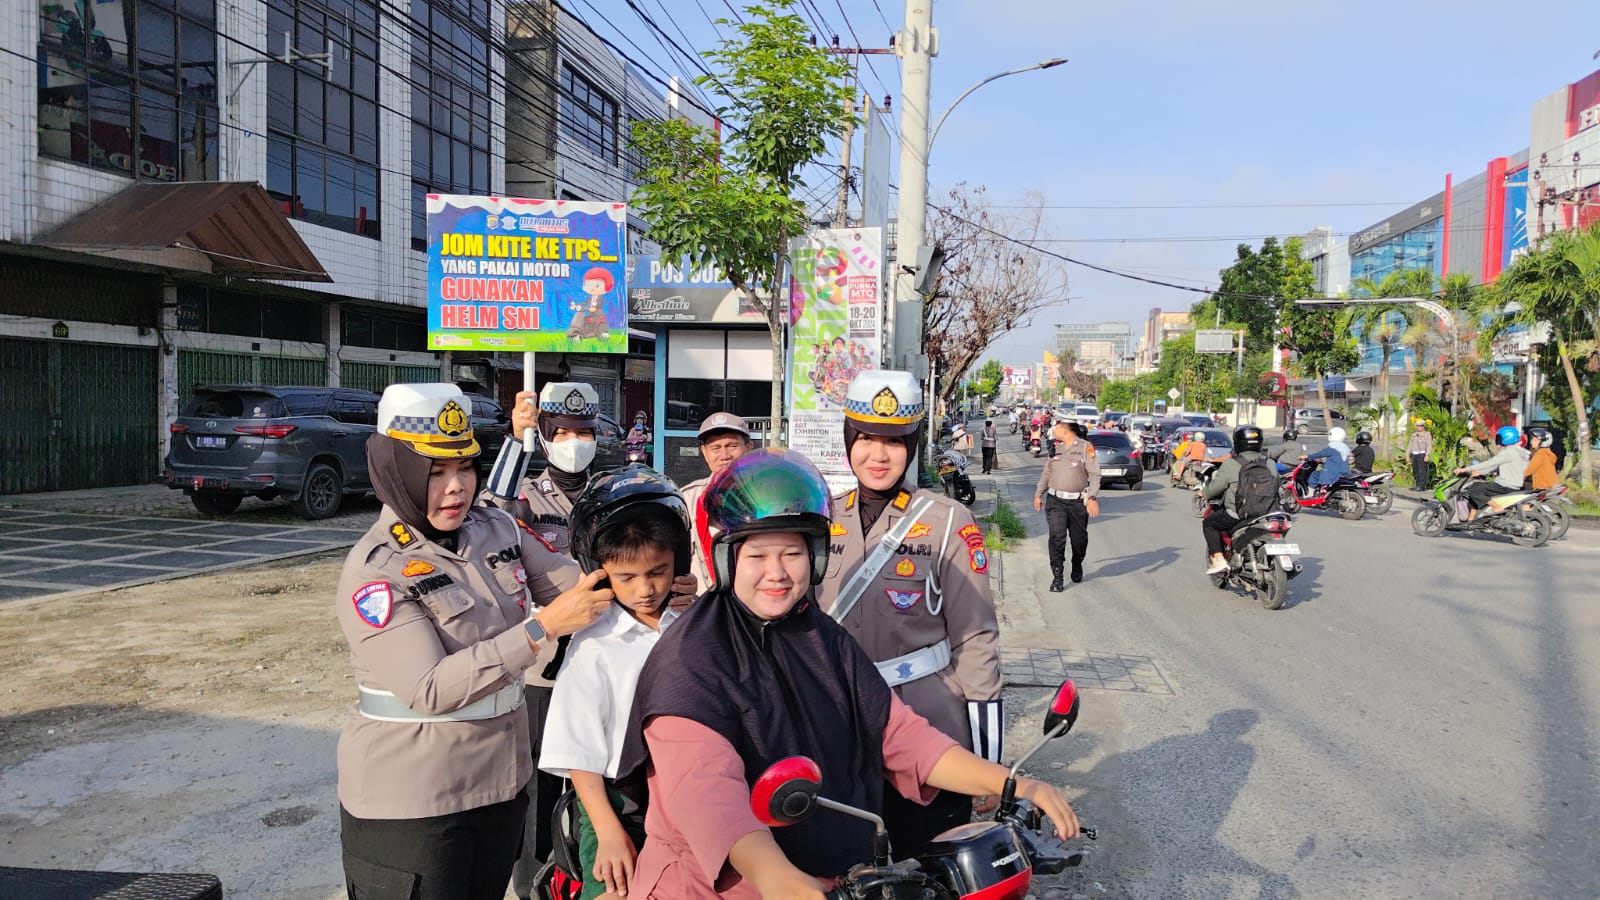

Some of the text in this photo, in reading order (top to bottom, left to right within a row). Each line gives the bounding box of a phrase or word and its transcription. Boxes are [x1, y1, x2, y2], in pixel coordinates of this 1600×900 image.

[440, 233, 483, 257] JOM
[487, 235, 532, 259] KITE
[535, 237, 560, 260] KE
[441, 259, 570, 278] YANG PAKAI MOTOR
[441, 277, 544, 303] GUNAKAN
[851, 289, 875, 298] MTQ
[633, 297, 690, 311] Alkaline
[441, 305, 540, 330] HELM SNI
[850, 306, 876, 319] 18-20
[850, 319, 862, 328] OKT
